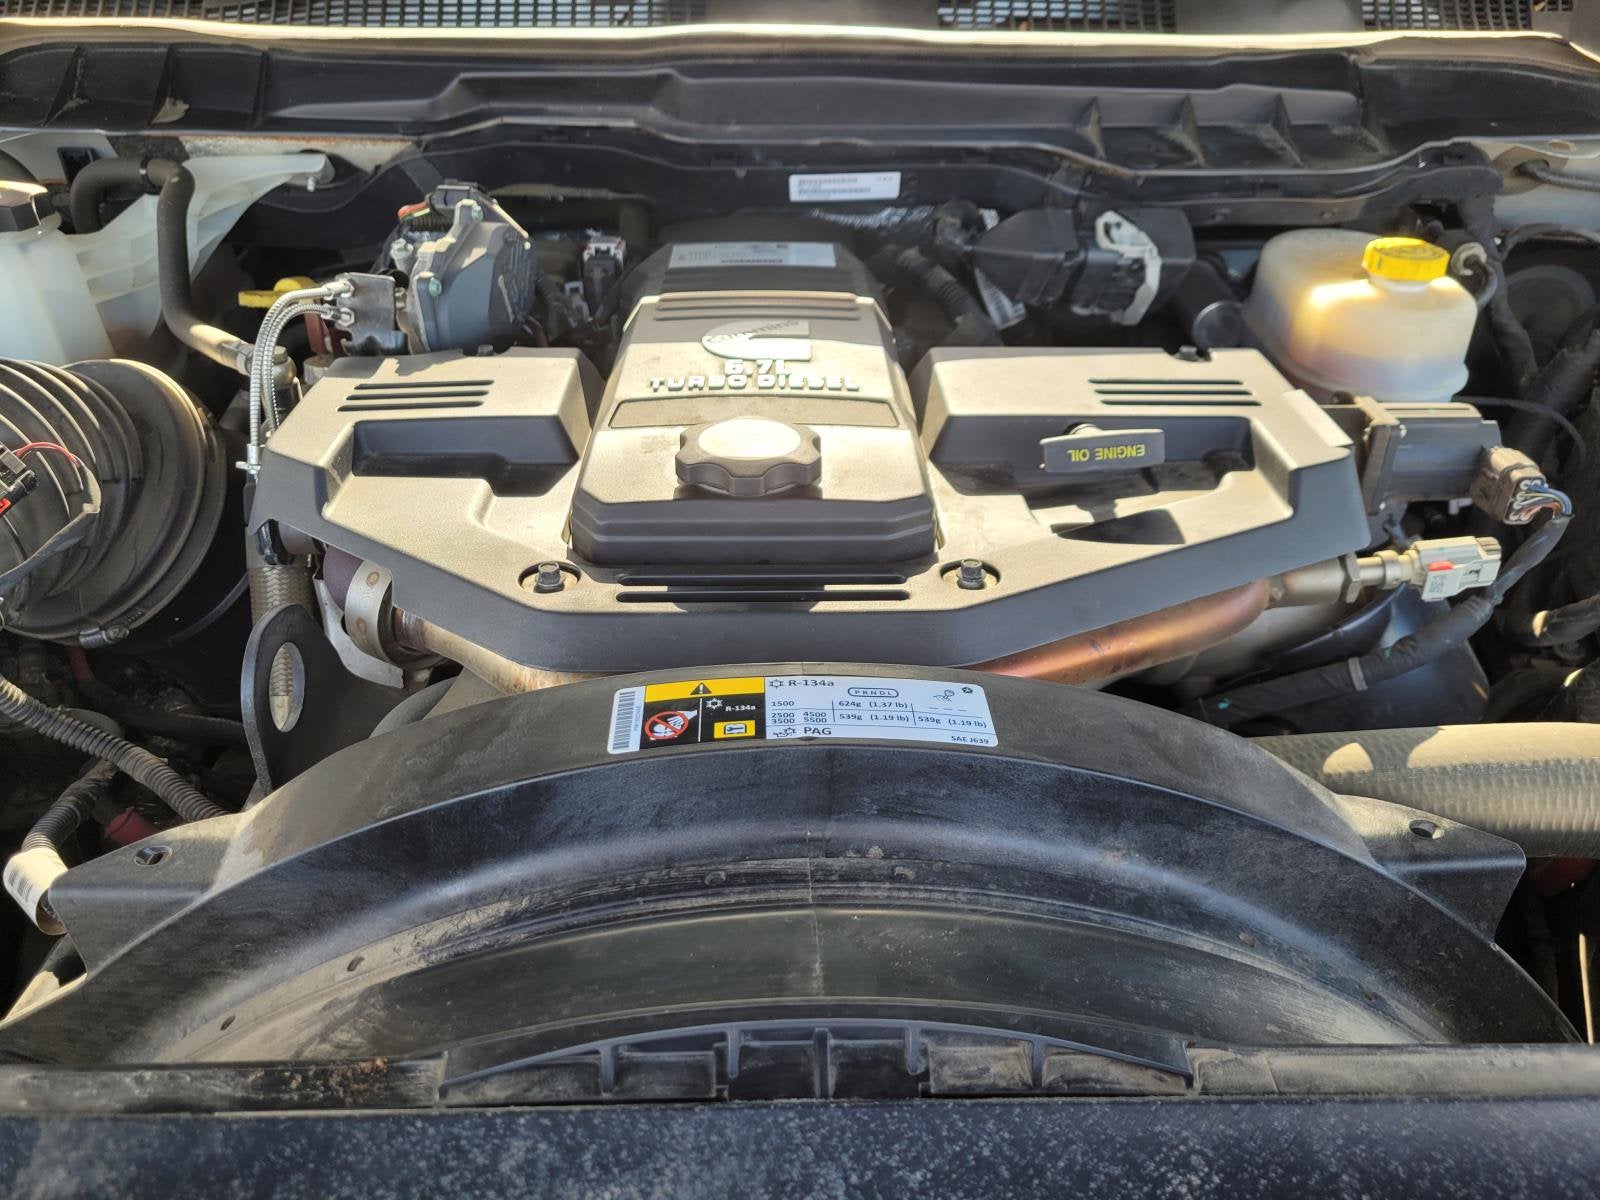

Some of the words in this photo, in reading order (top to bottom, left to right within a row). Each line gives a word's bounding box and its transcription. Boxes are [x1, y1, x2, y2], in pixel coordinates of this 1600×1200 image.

[650, 374, 750, 392] TURBO
[756, 374, 860, 392] DIESEL
[1067, 448, 1091, 463] OIL
[1095, 444, 1146, 461] ENGINE
[787, 679, 835, 687] R-134a
[725, 704, 756, 712] R-134a
[838, 700, 862, 708] 624g
[839, 713, 863, 721] 539g
[896, 715, 909, 723] lb)
[918, 716, 942, 724] 539g
[948, 718, 973, 727] (1.19
[974, 720, 987, 729] lb)
[803, 727, 832, 735] PAG
[969, 737, 990, 745] J639
